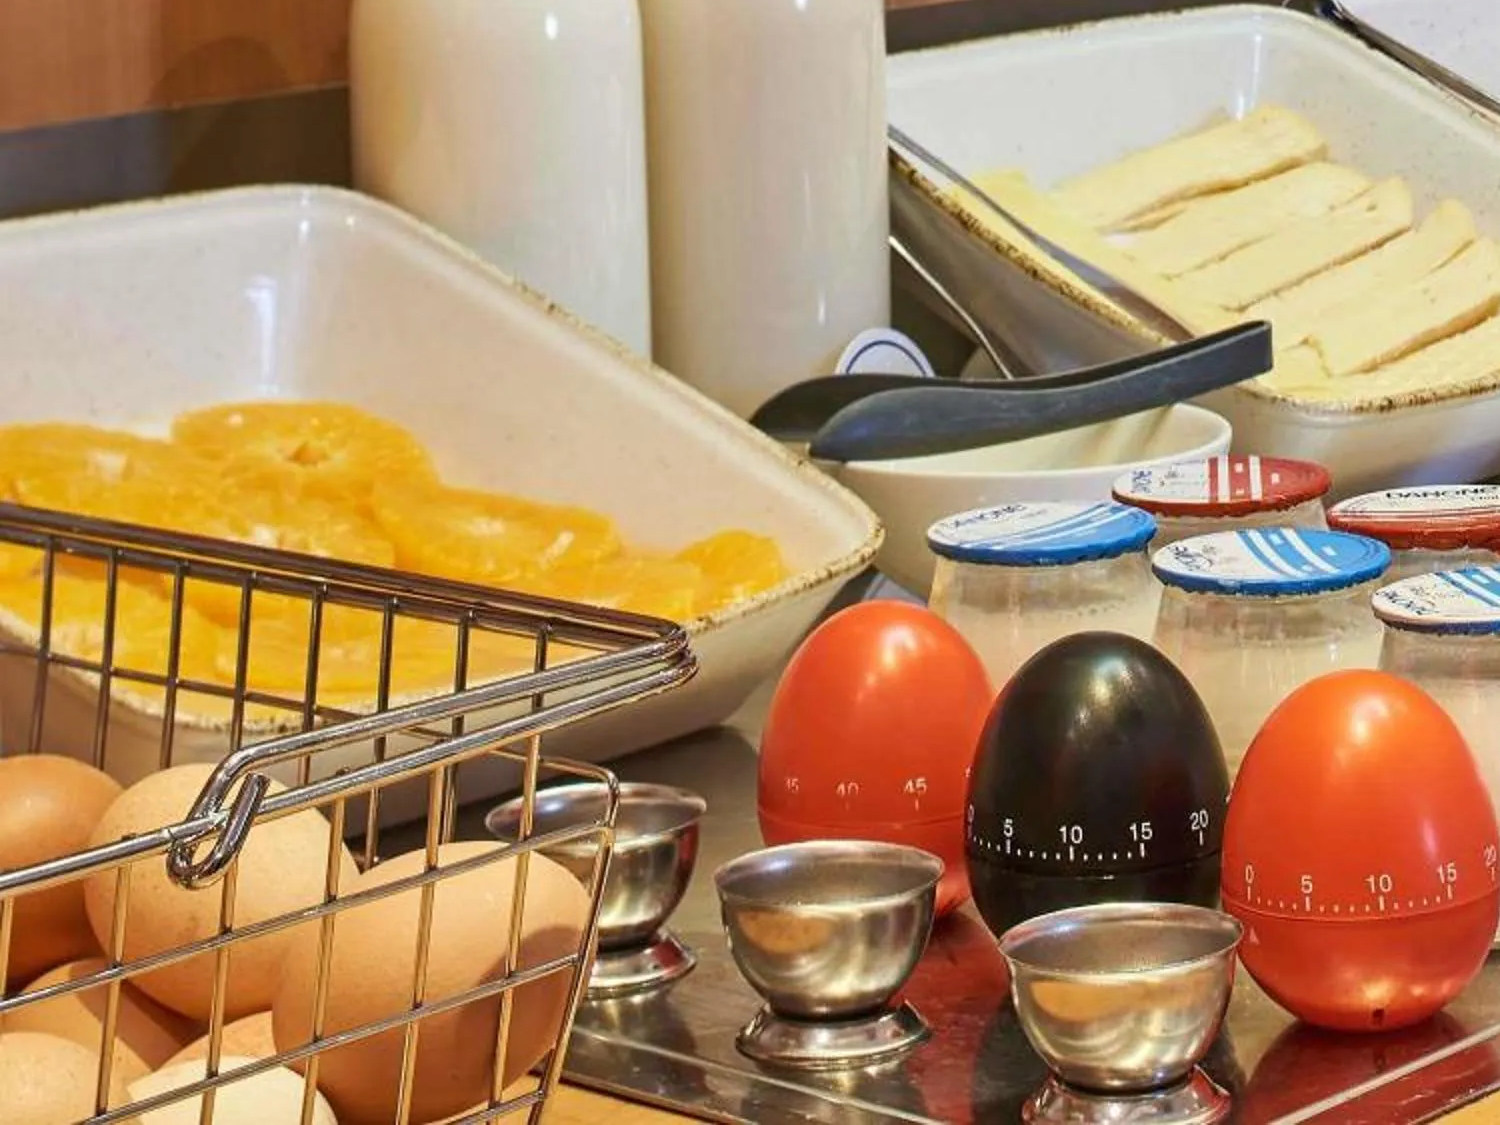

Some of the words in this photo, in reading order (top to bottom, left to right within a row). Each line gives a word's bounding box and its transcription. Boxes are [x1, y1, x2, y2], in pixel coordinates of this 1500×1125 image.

[904, 777, 928, 796] 45
[1003, 819, 1013, 838] 5
[1059, 826, 1083, 844] 10
[1130, 823, 1153, 842] 15
[1190, 810, 1209, 831] 20
[1244, 864, 1255, 884] 0
[1300, 874, 1313, 894] 5
[1365, 874, 1392, 893] 10
[1436, 862, 1457, 883] 15
[1483, 845, 1497, 867] 20
